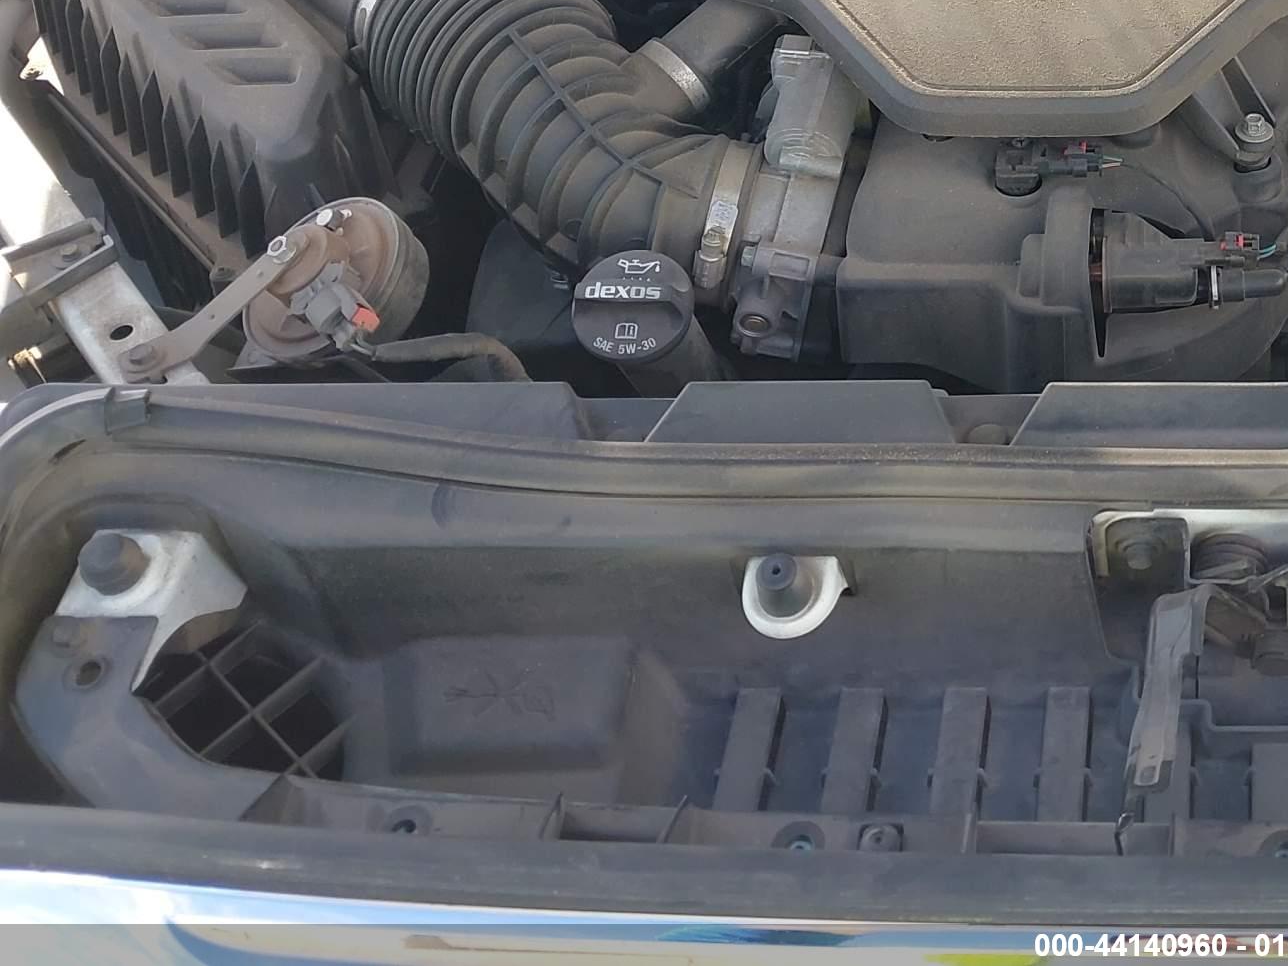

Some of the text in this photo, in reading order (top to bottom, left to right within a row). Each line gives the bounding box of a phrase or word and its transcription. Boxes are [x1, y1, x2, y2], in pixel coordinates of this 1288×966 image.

[584, 281, 662, 300] dexos
[593, 337, 656, 355] SAE 5W-30
